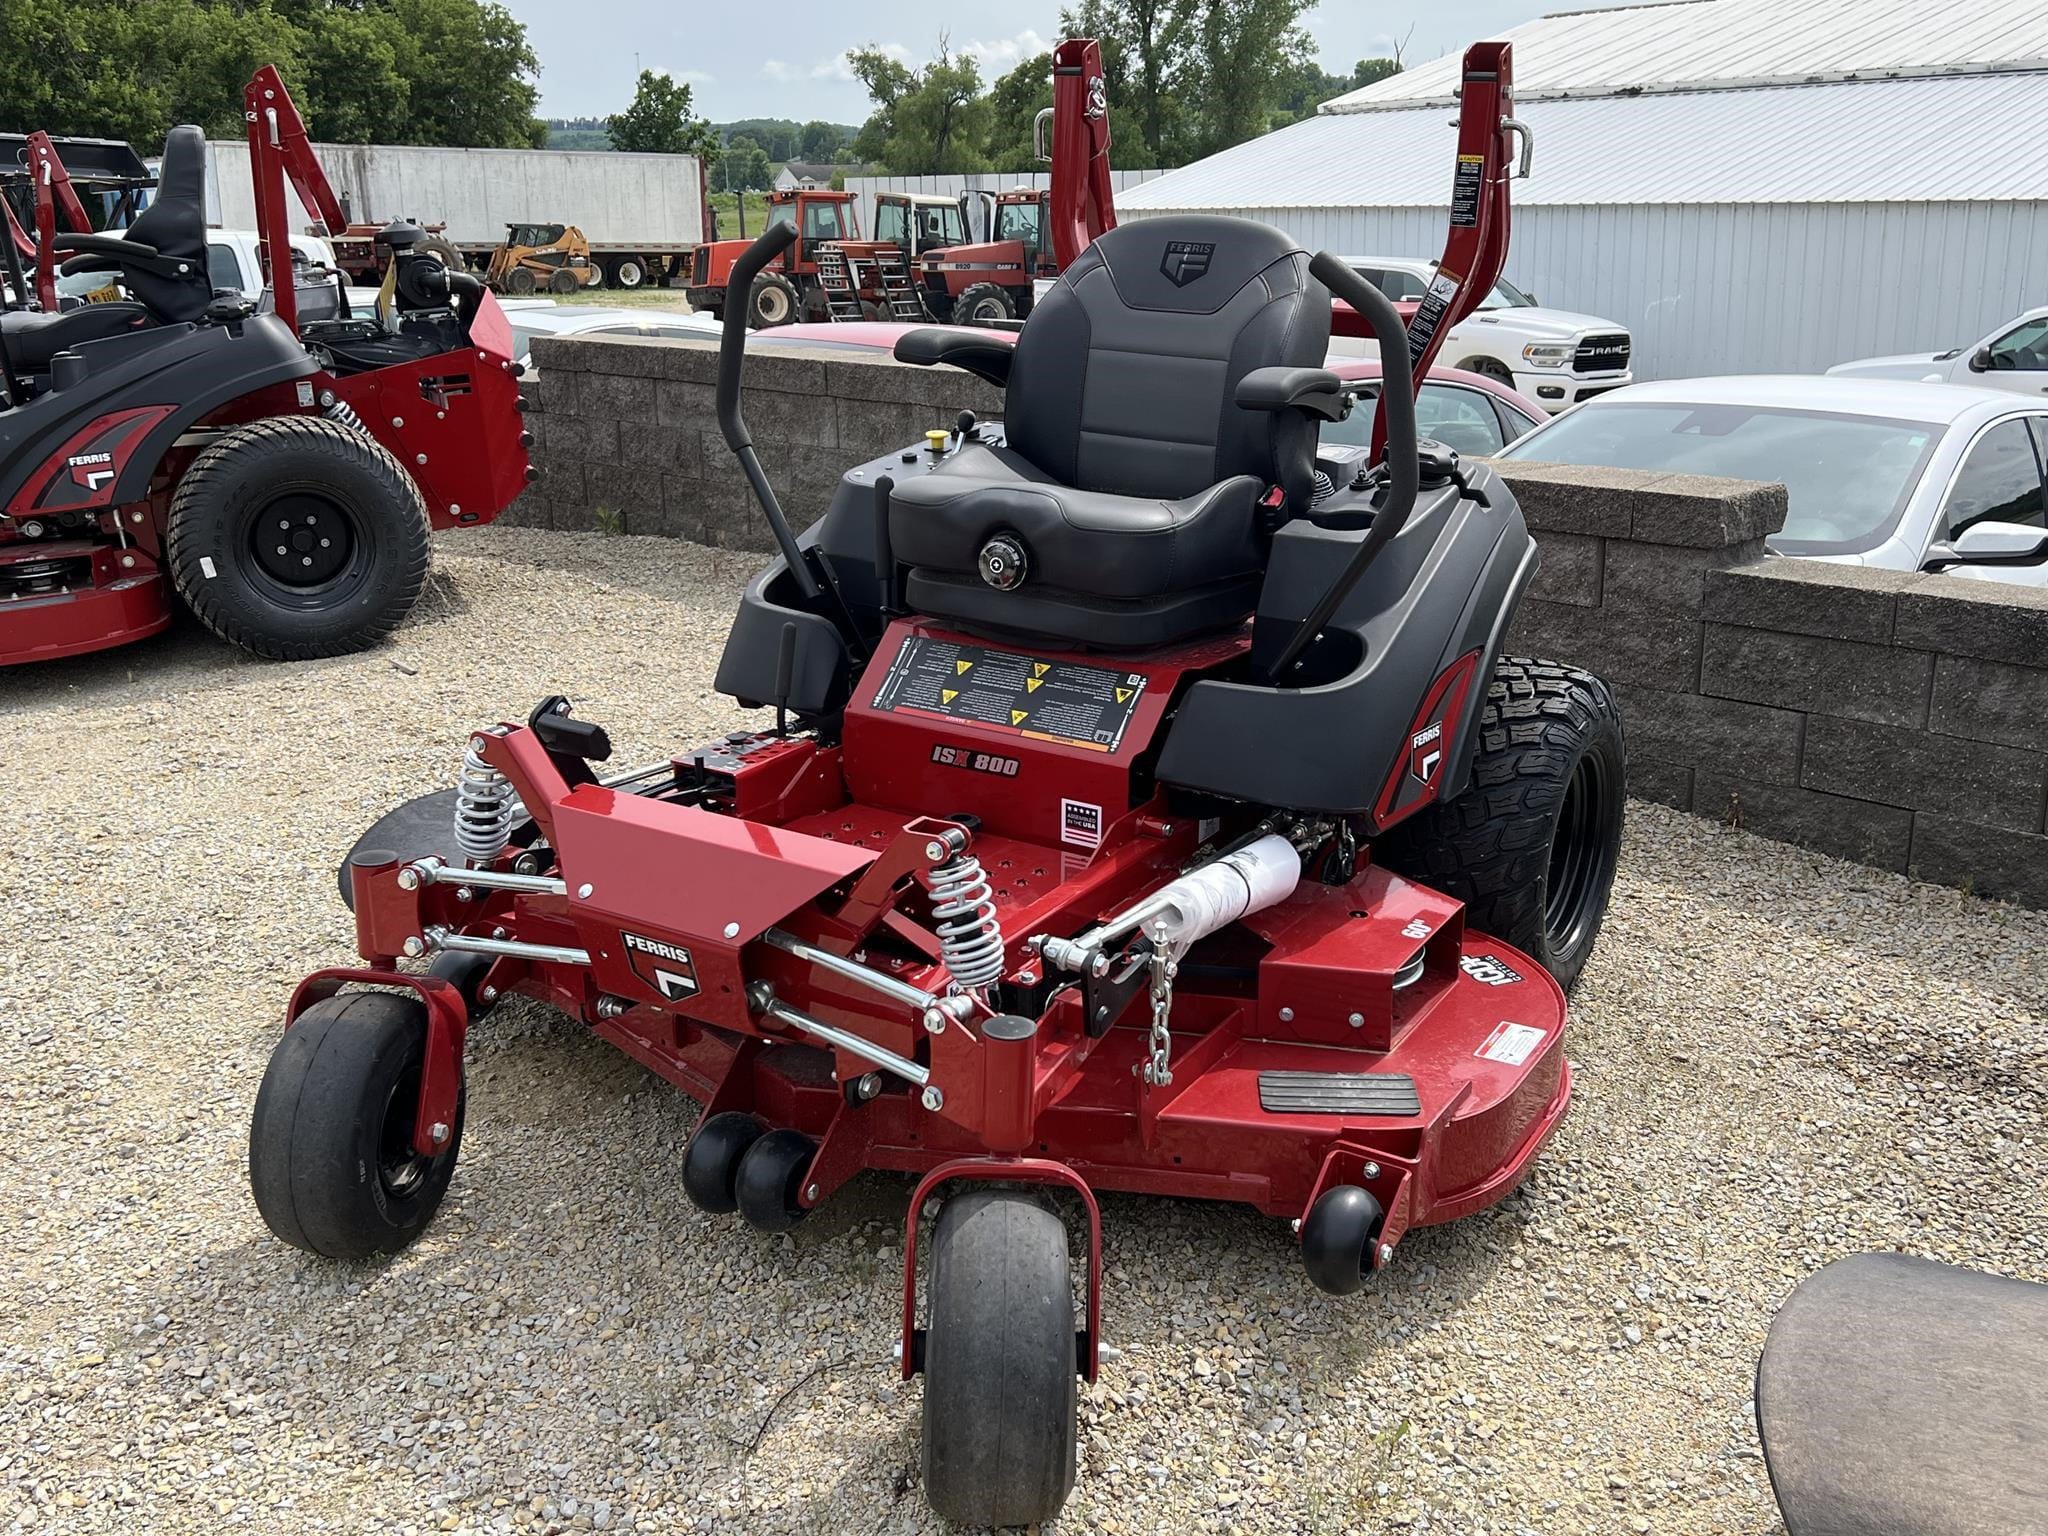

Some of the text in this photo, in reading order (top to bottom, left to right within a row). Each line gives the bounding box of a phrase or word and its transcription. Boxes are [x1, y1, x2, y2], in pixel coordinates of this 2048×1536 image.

[1169, 242, 1212, 254] FERRIS
[1596, 346, 1620, 355] RAM
[68, 452, 111, 466] FERRIS
[1413, 725, 1440, 749] FERRIS
[932, 745, 1018, 775] ISX 800
[625, 934, 688, 963] FERRIS
